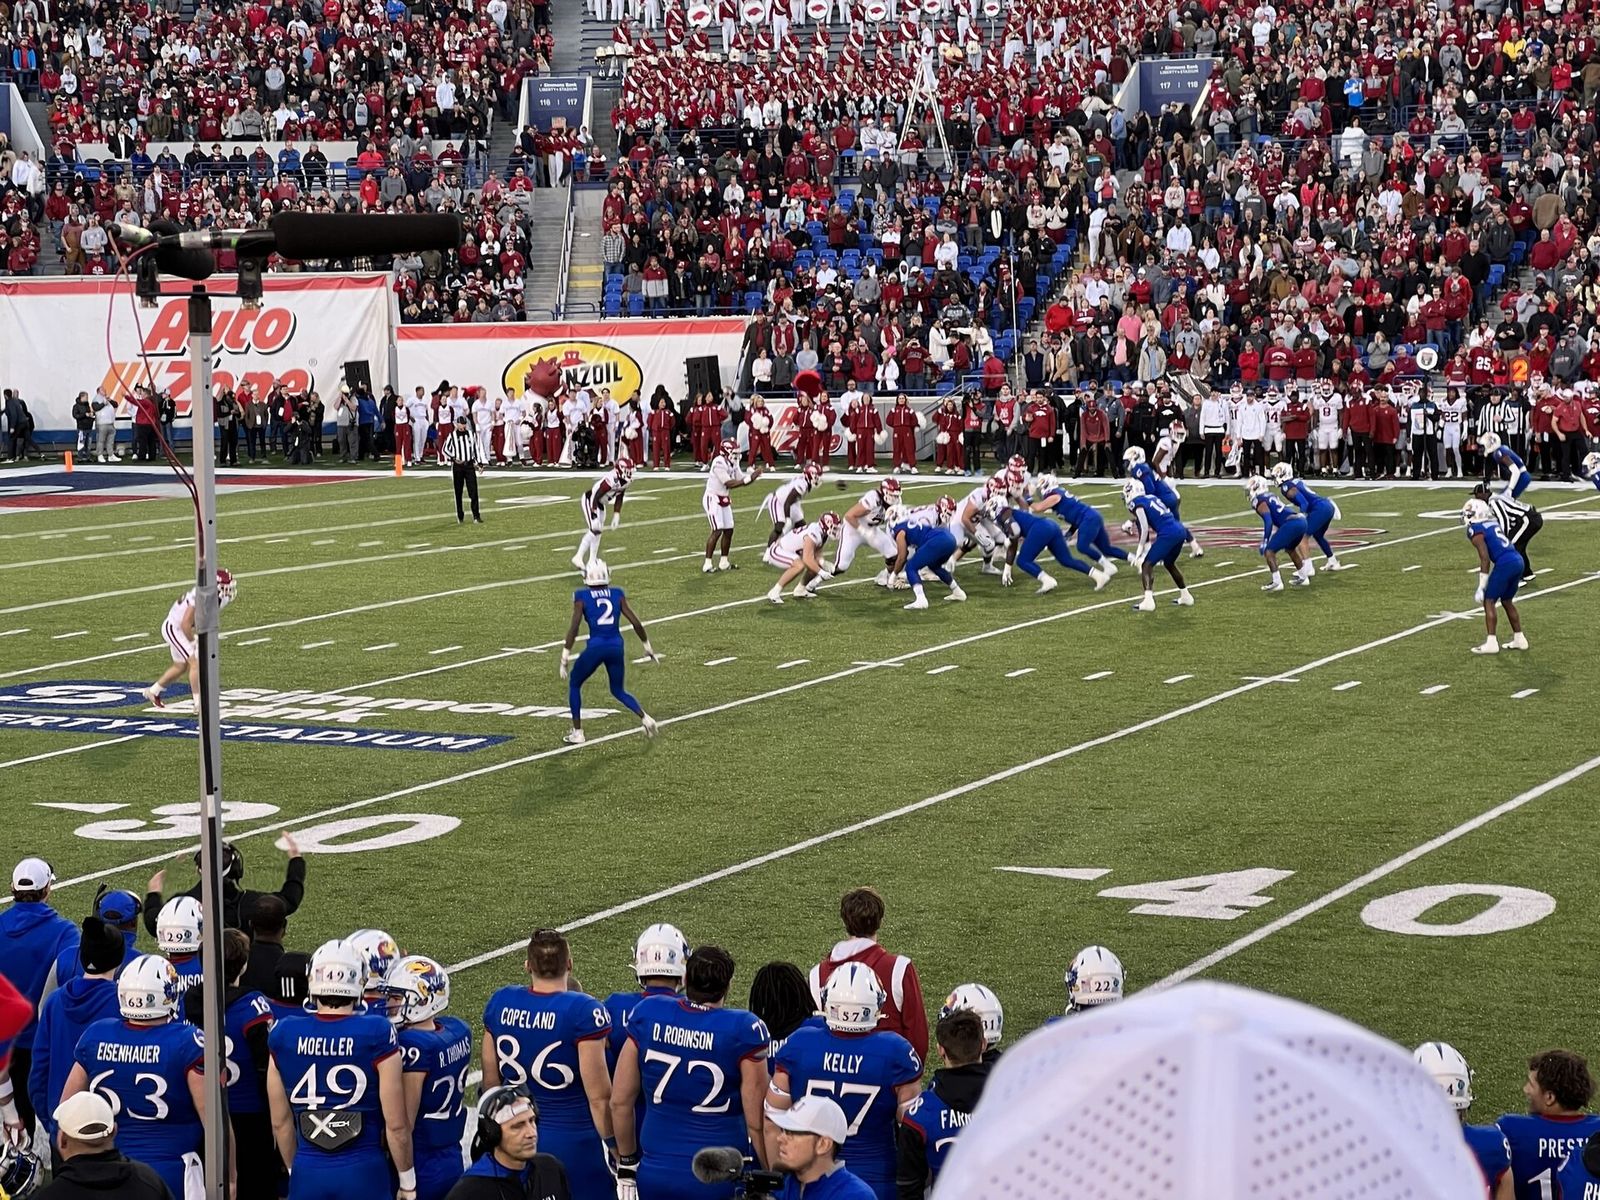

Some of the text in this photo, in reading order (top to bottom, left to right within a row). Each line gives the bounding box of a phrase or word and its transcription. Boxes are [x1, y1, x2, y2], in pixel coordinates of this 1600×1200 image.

[1475, 356, 1492, 371] 25
[596, 597, 615, 626] 2
[167, 932, 184, 943] 29
[654, 951, 662, 962] 8
[326, 970, 345, 981] 49
[1094, 980, 1111, 992] 22
[128, 997, 144, 1008] 63
[250, 995, 271, 1016] 18
[500, 1007, 557, 1030] COPELAND
[842, 1011, 861, 1022] 57
[297, 1036, 354, 1057] MOELLER
[652, 1023, 714, 1051] D. ROBINSON
[96, 1041, 161, 1064] EISENHAUER
[446, 1035, 471, 1065] THOMAS
[496, 1034, 575, 1090] 86
[823, 1051, 864, 1075] KELLY
[290, 1062, 367, 1111] 49
[644, 1048, 732, 1114] 72
